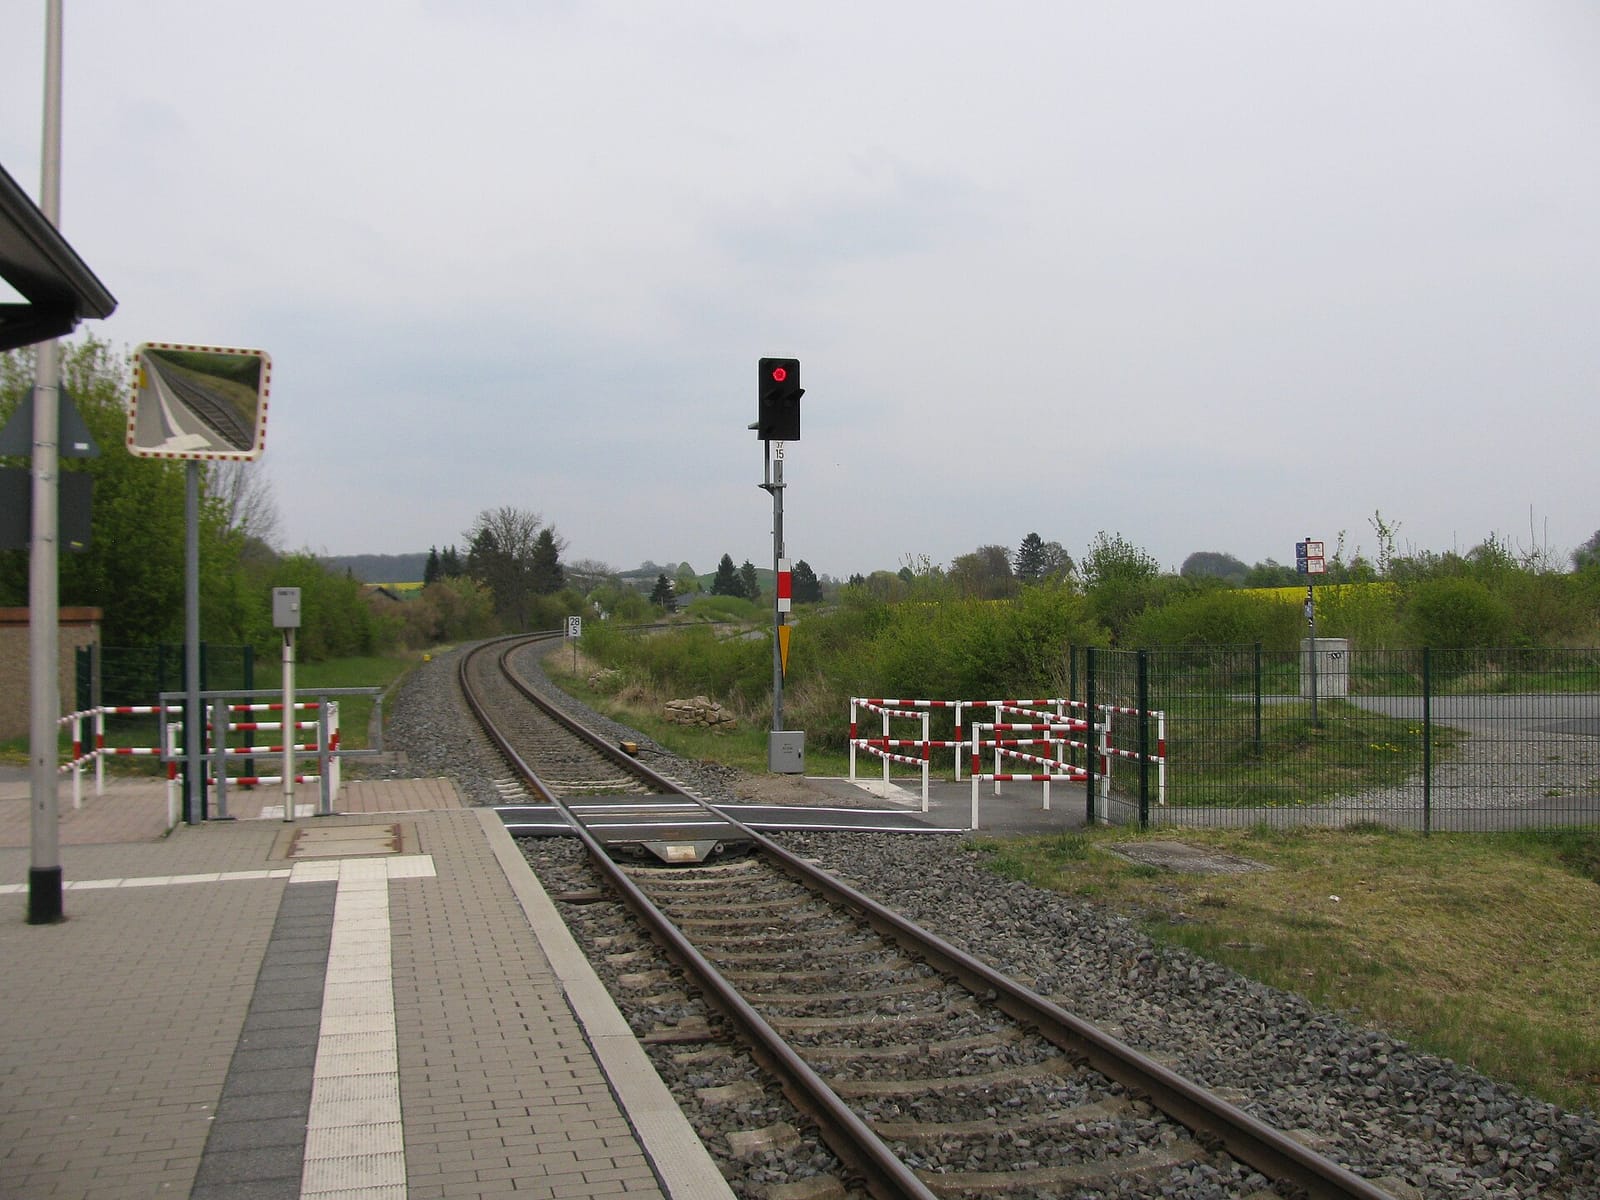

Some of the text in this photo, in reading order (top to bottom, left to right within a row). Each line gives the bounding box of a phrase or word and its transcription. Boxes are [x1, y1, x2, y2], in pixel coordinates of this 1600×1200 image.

[776, 449, 784, 459] 15
[570, 617, 580, 626] 28
[572, 626, 578, 634] 5
